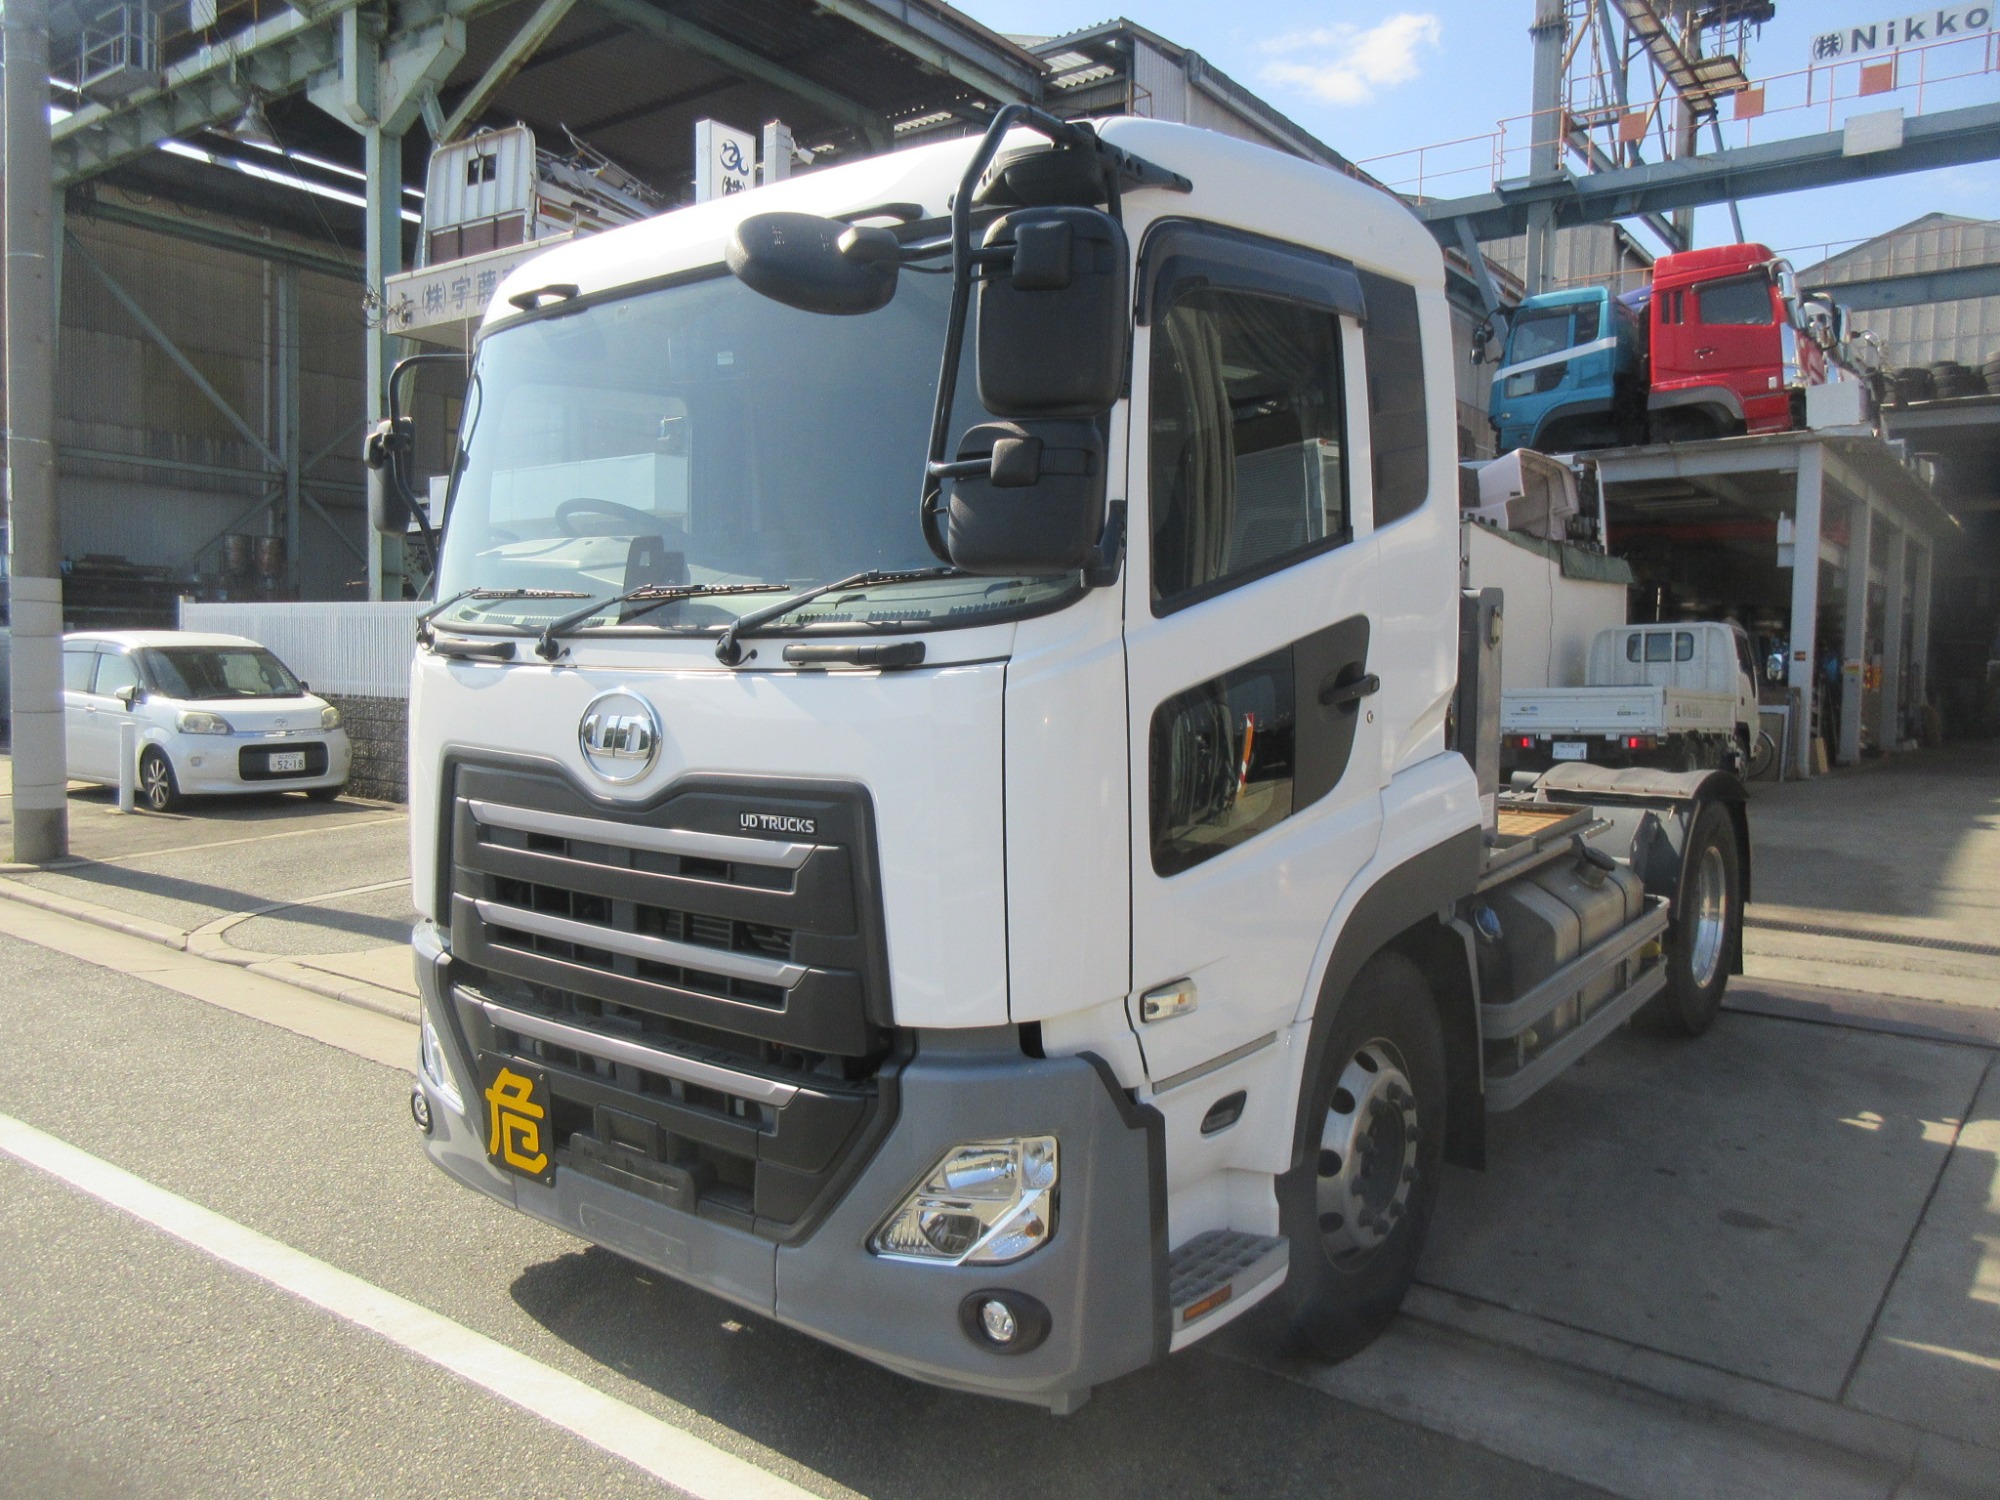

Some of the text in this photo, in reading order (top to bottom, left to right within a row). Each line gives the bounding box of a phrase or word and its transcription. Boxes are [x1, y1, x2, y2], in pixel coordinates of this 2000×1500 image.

[740, 813, 815, 833] UD TRUCKS
[484, 1067, 548, 1174] 危
